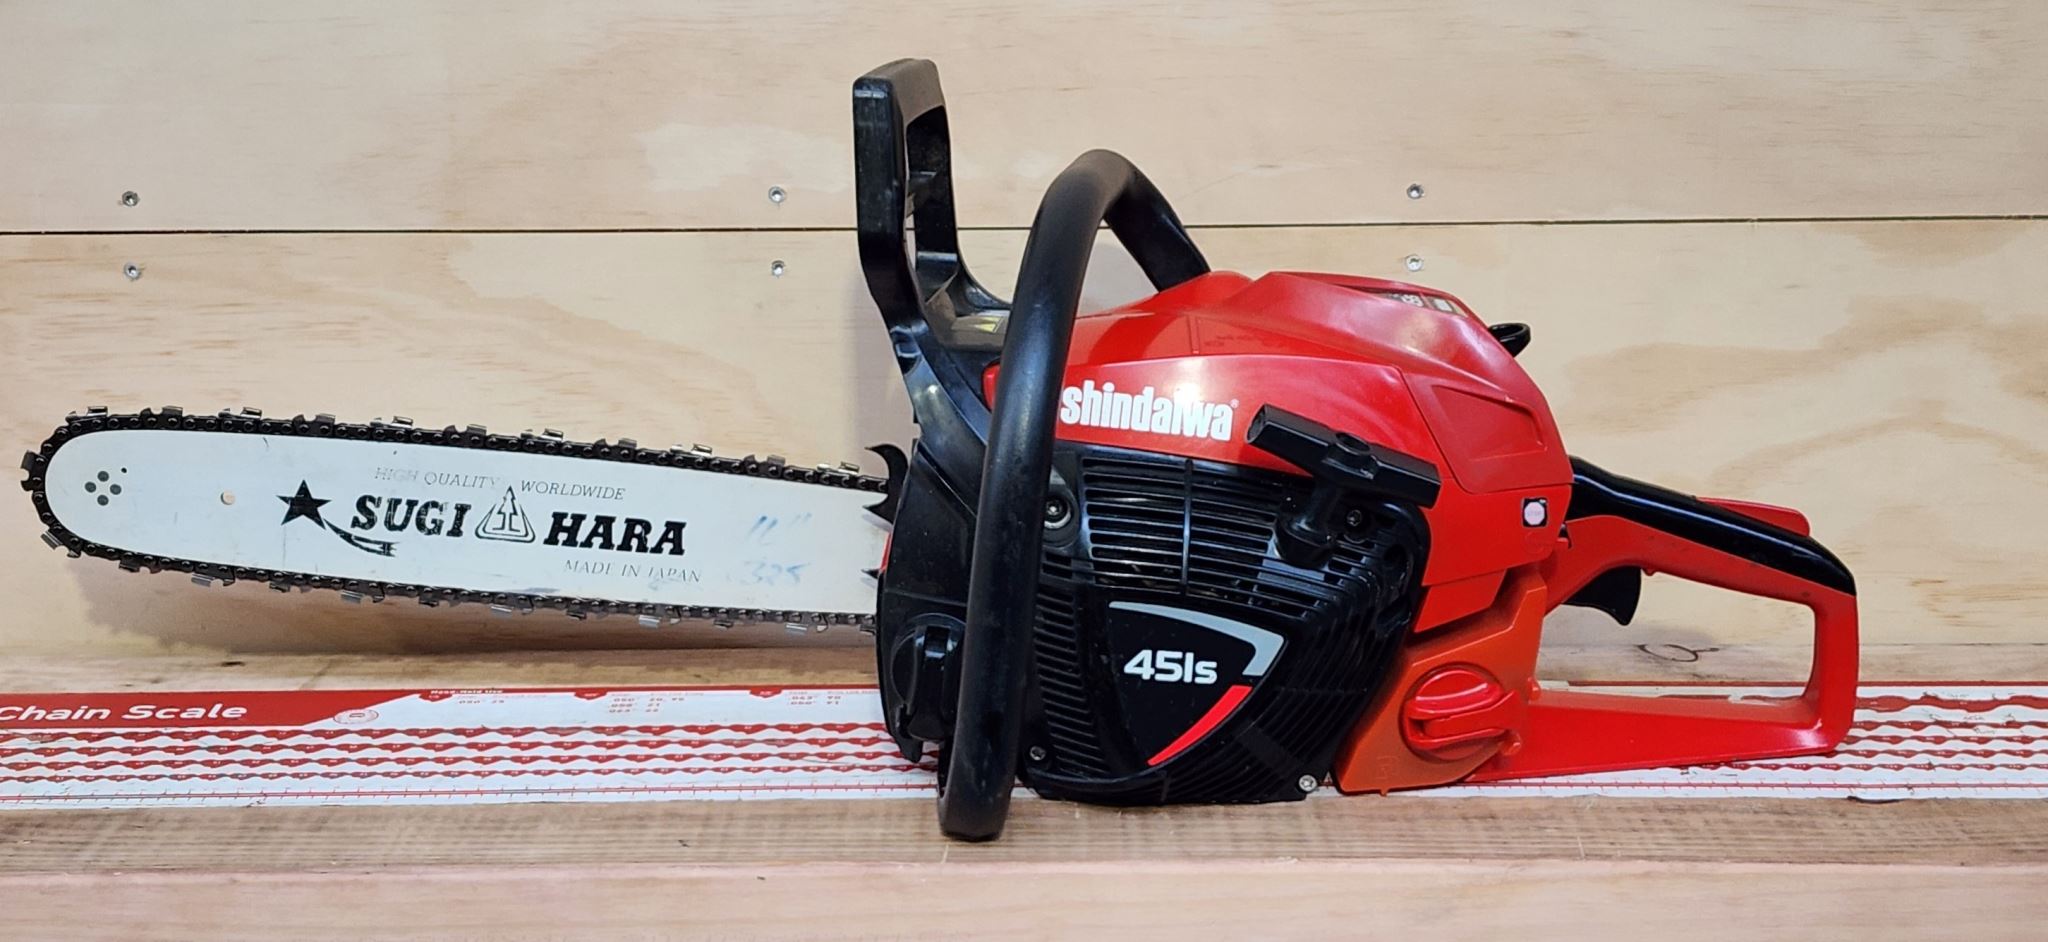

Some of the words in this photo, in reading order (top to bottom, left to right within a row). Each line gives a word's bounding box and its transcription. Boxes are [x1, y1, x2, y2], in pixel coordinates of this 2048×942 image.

[1060, 379, 1234, 442] shindaiwa
[521, 480, 627, 501] WORLDWIDE
[351, 494, 472, 538] SUGI
[543, 511, 687, 556] HARA
[565, 559, 613, 576] MADE
[621, 564, 642, 577] IN
[649, 567, 702, 583] JAPAN
[0, 705, 111, 721] Chain
[121, 703, 248, 720] Scale
